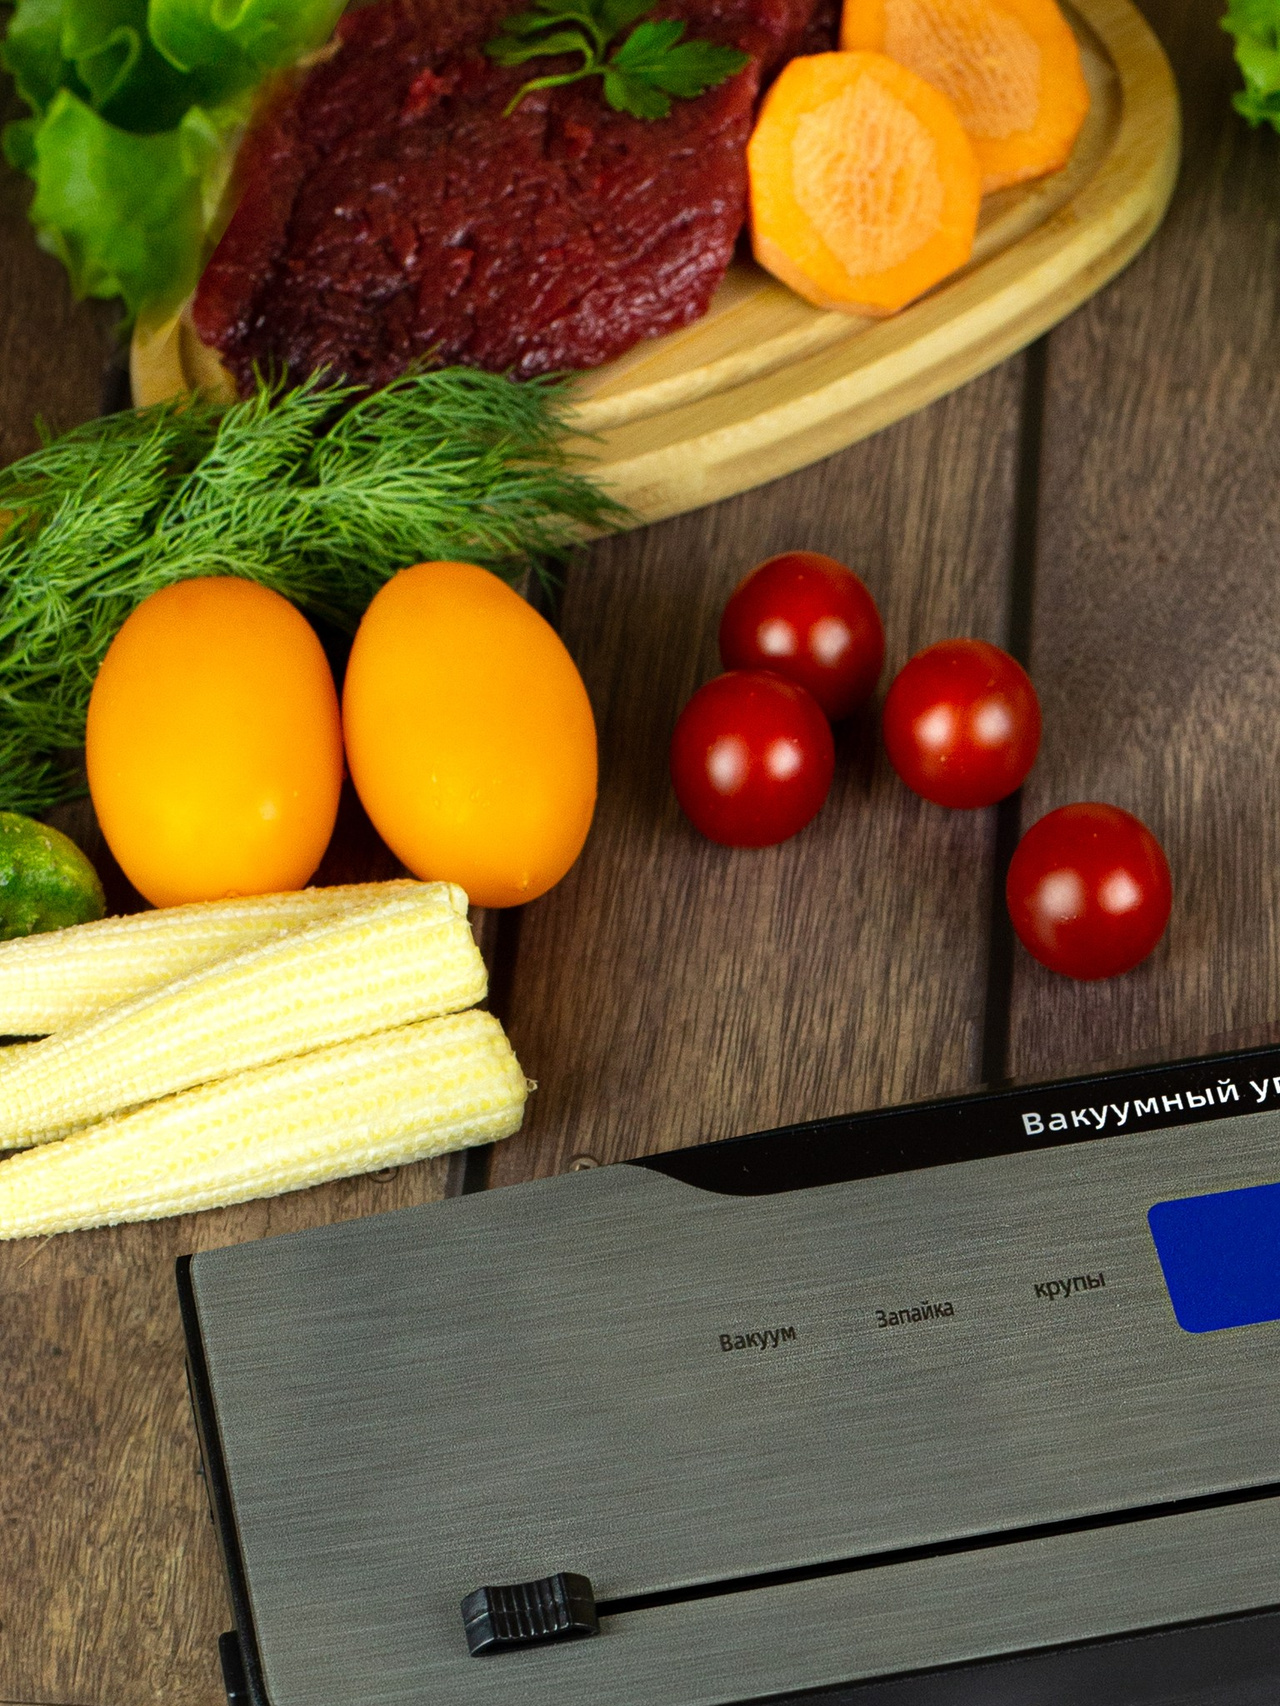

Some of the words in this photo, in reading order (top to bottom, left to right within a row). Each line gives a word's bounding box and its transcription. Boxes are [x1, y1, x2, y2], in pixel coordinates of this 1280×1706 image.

[1021, 1081, 1239, 1136] Вакуумный
[1033, 1272, 1106, 1300] крупы
[875, 1299, 955, 1328] Запайка
[718, 1324, 796, 1352] Вакуум
